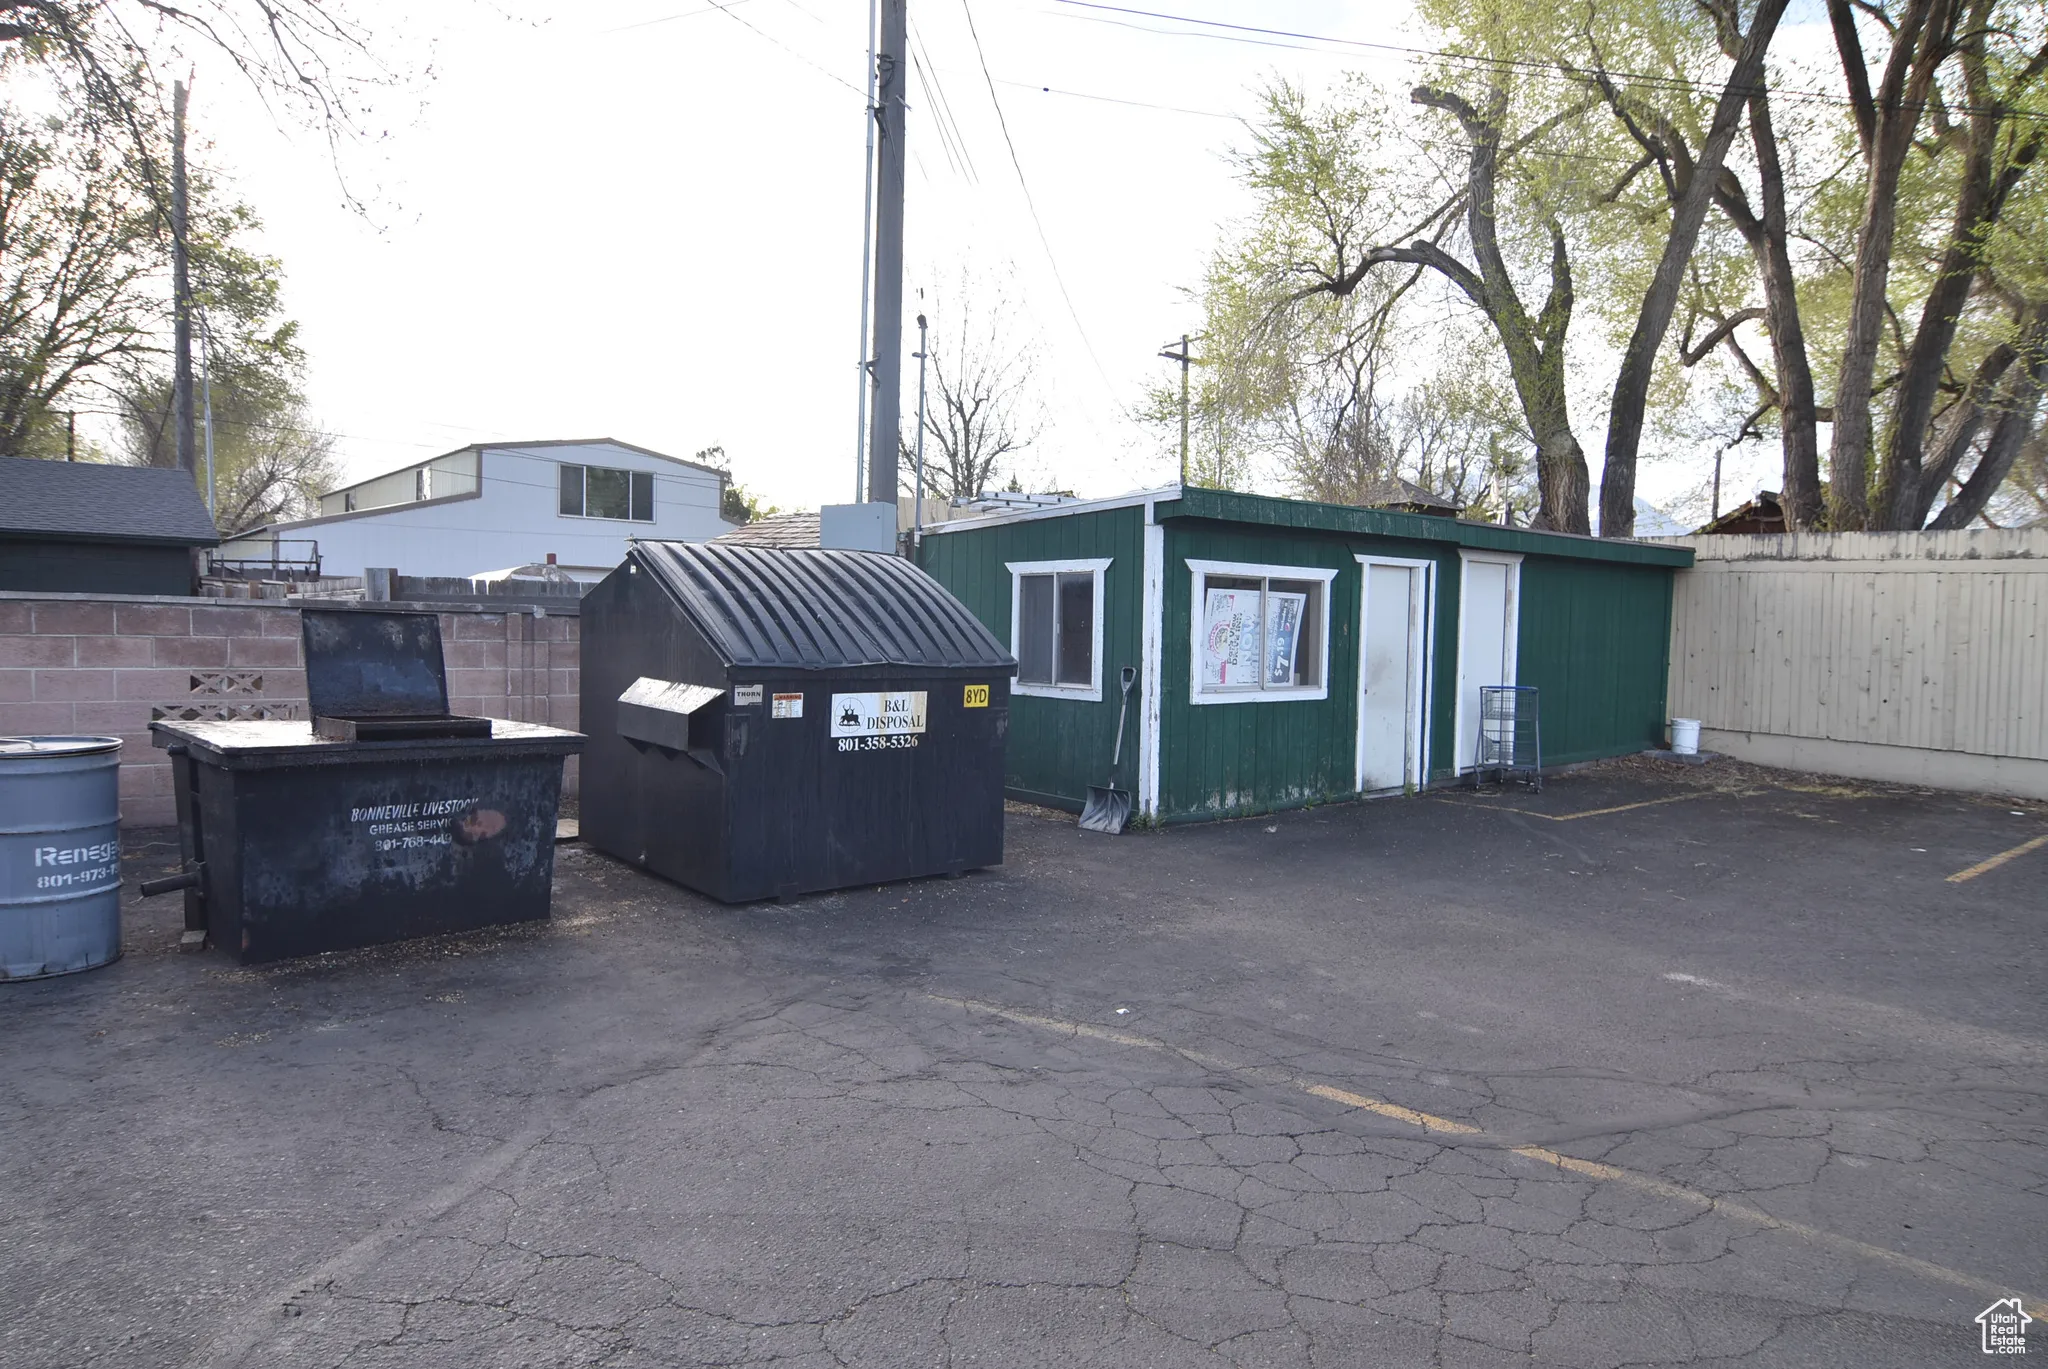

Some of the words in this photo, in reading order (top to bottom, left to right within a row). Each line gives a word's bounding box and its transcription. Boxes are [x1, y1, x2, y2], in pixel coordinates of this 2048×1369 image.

[966, 688, 987, 704] 8YD
[884, 699, 909, 713] B&L
[867, 714, 924, 730] DISPOSAL
[838, 735, 918, 752] 801-358-5326
[351, 803, 420, 822] BONNEVILLE
[369, 822, 415, 835] GREASE
[37, 863, 118, 888] 801-973-1
